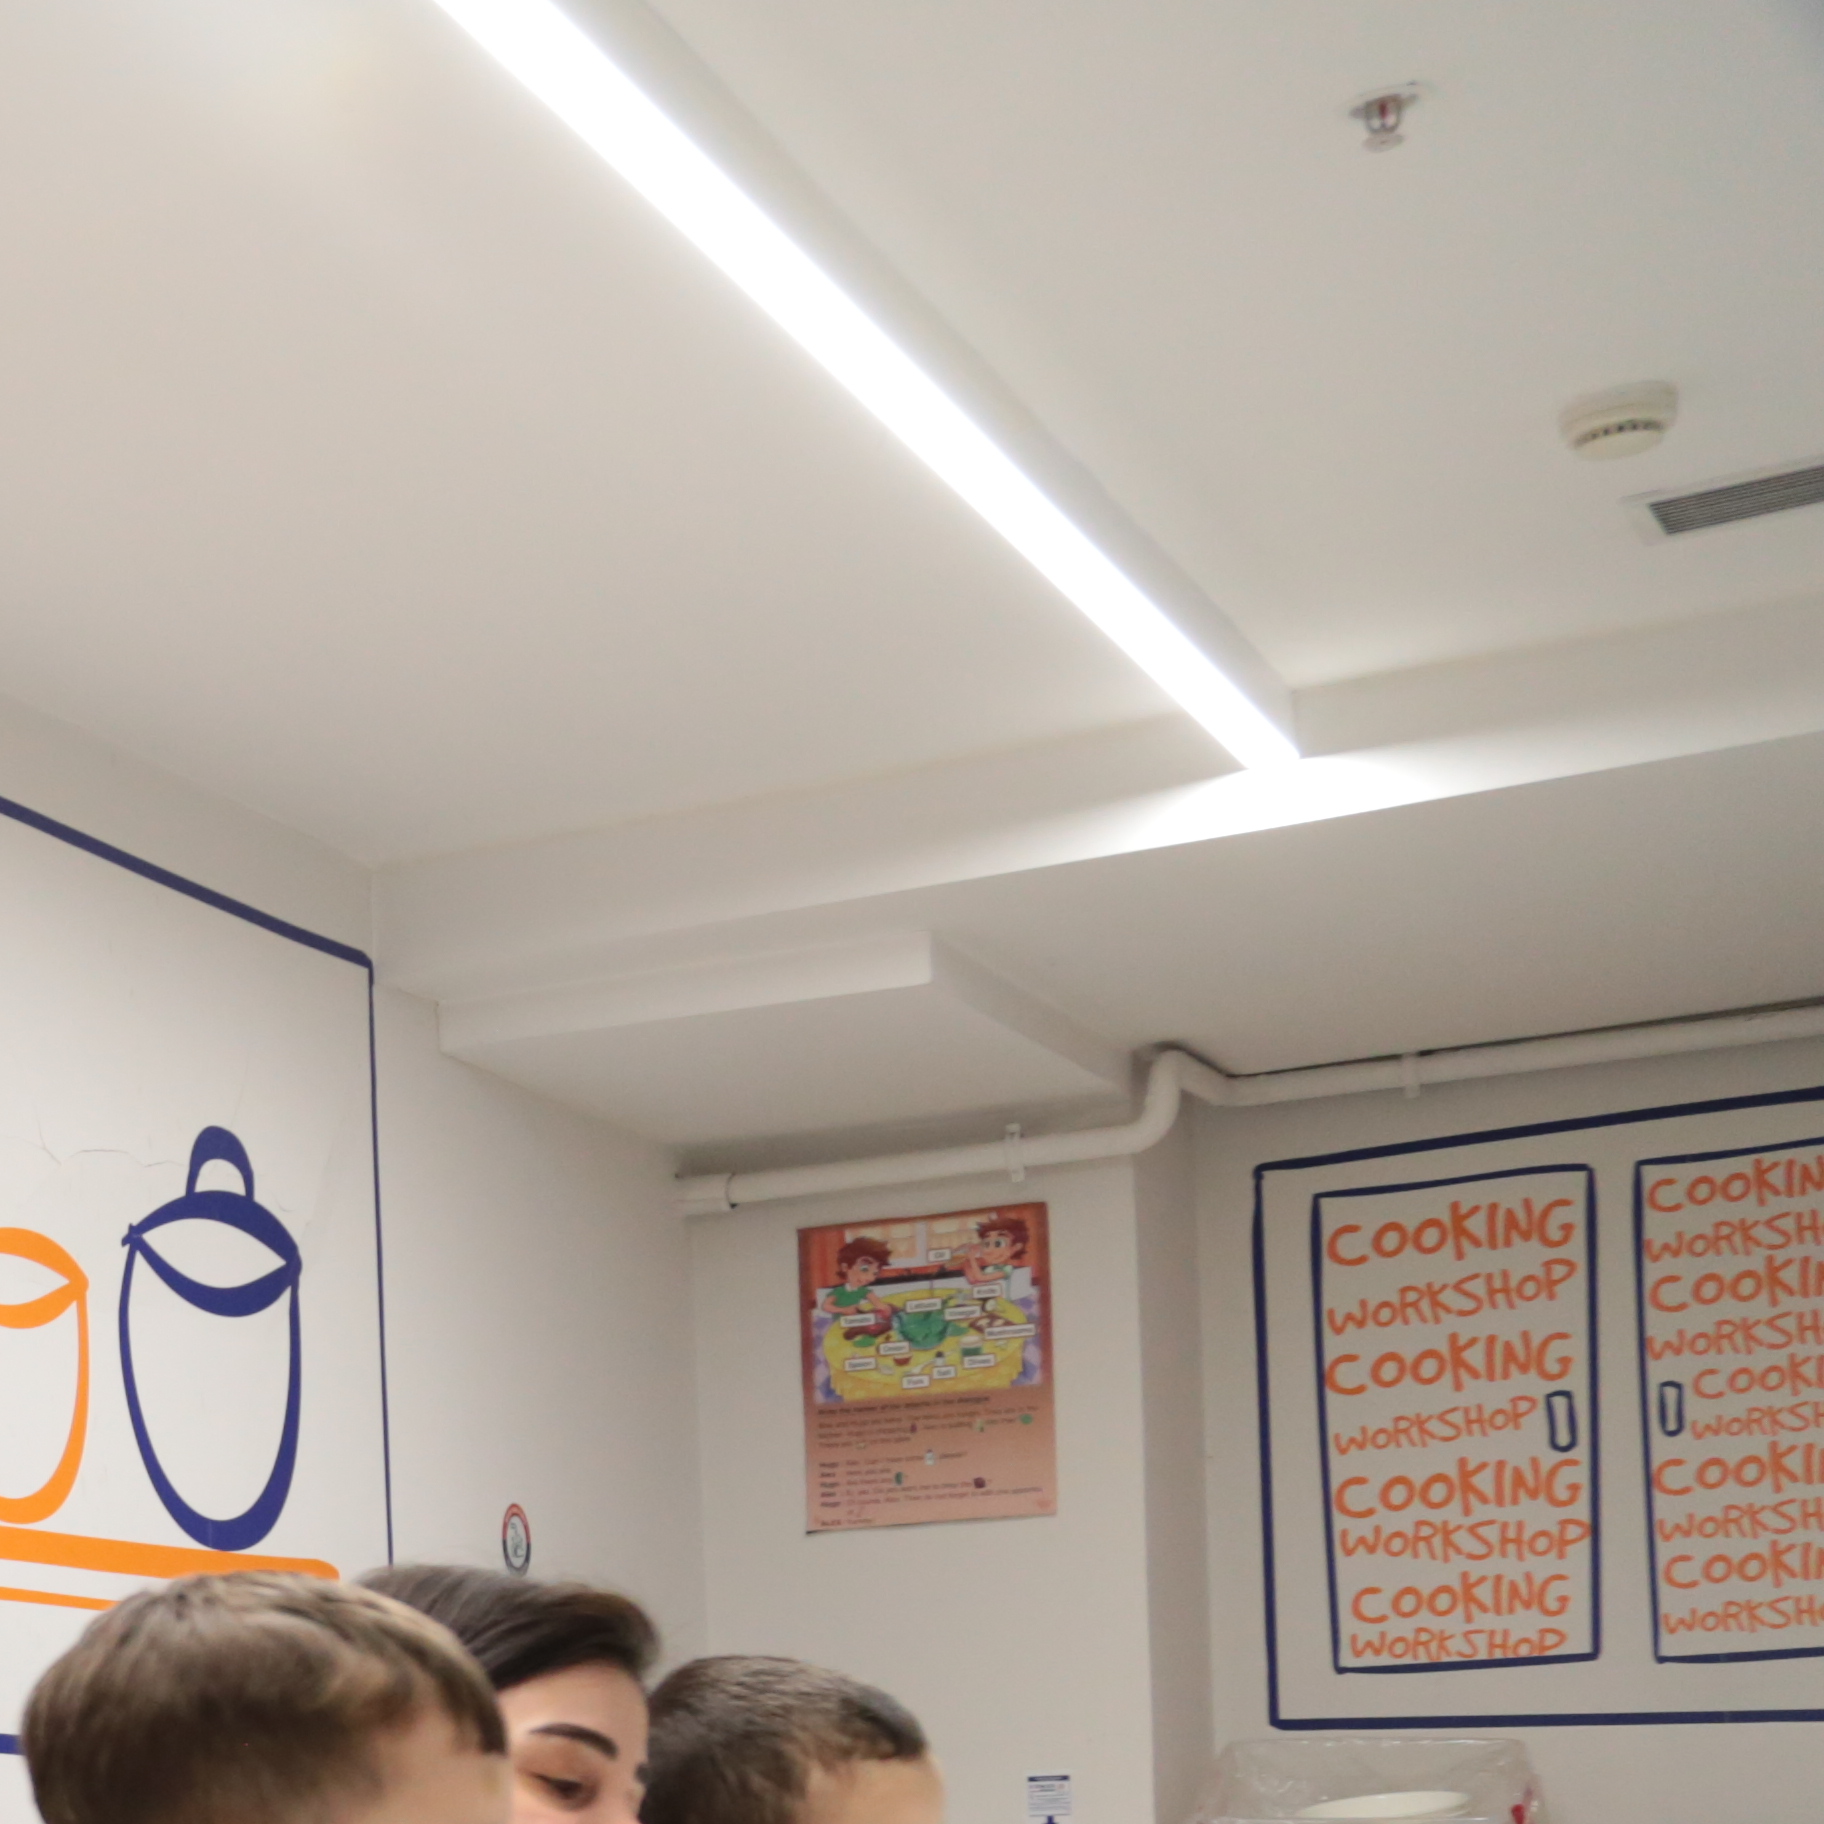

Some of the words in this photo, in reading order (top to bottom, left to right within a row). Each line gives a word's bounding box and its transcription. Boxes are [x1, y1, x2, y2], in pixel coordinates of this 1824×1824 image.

[1326, 1198, 1576, 1266] COOKING
[1645, 1210, 1824, 1262] WORKSH
[1327, 1258, 1579, 1335] WORKSHOP
[1326, 1331, 1574, 1395] COOKING
[1334, 1395, 1538, 1455] WORKSHOP
[1334, 1456, 1583, 1518] COOKING
[1654, 1441, 1824, 1496] COOKI
[1340, 1518, 1591, 1563] WORKSHOP
[1352, 1571, 1571, 1624] COOKING
[1663, 1595, 1824, 1634] WORKSH
[1351, 1627, 1567, 1661] WORKSHOP
